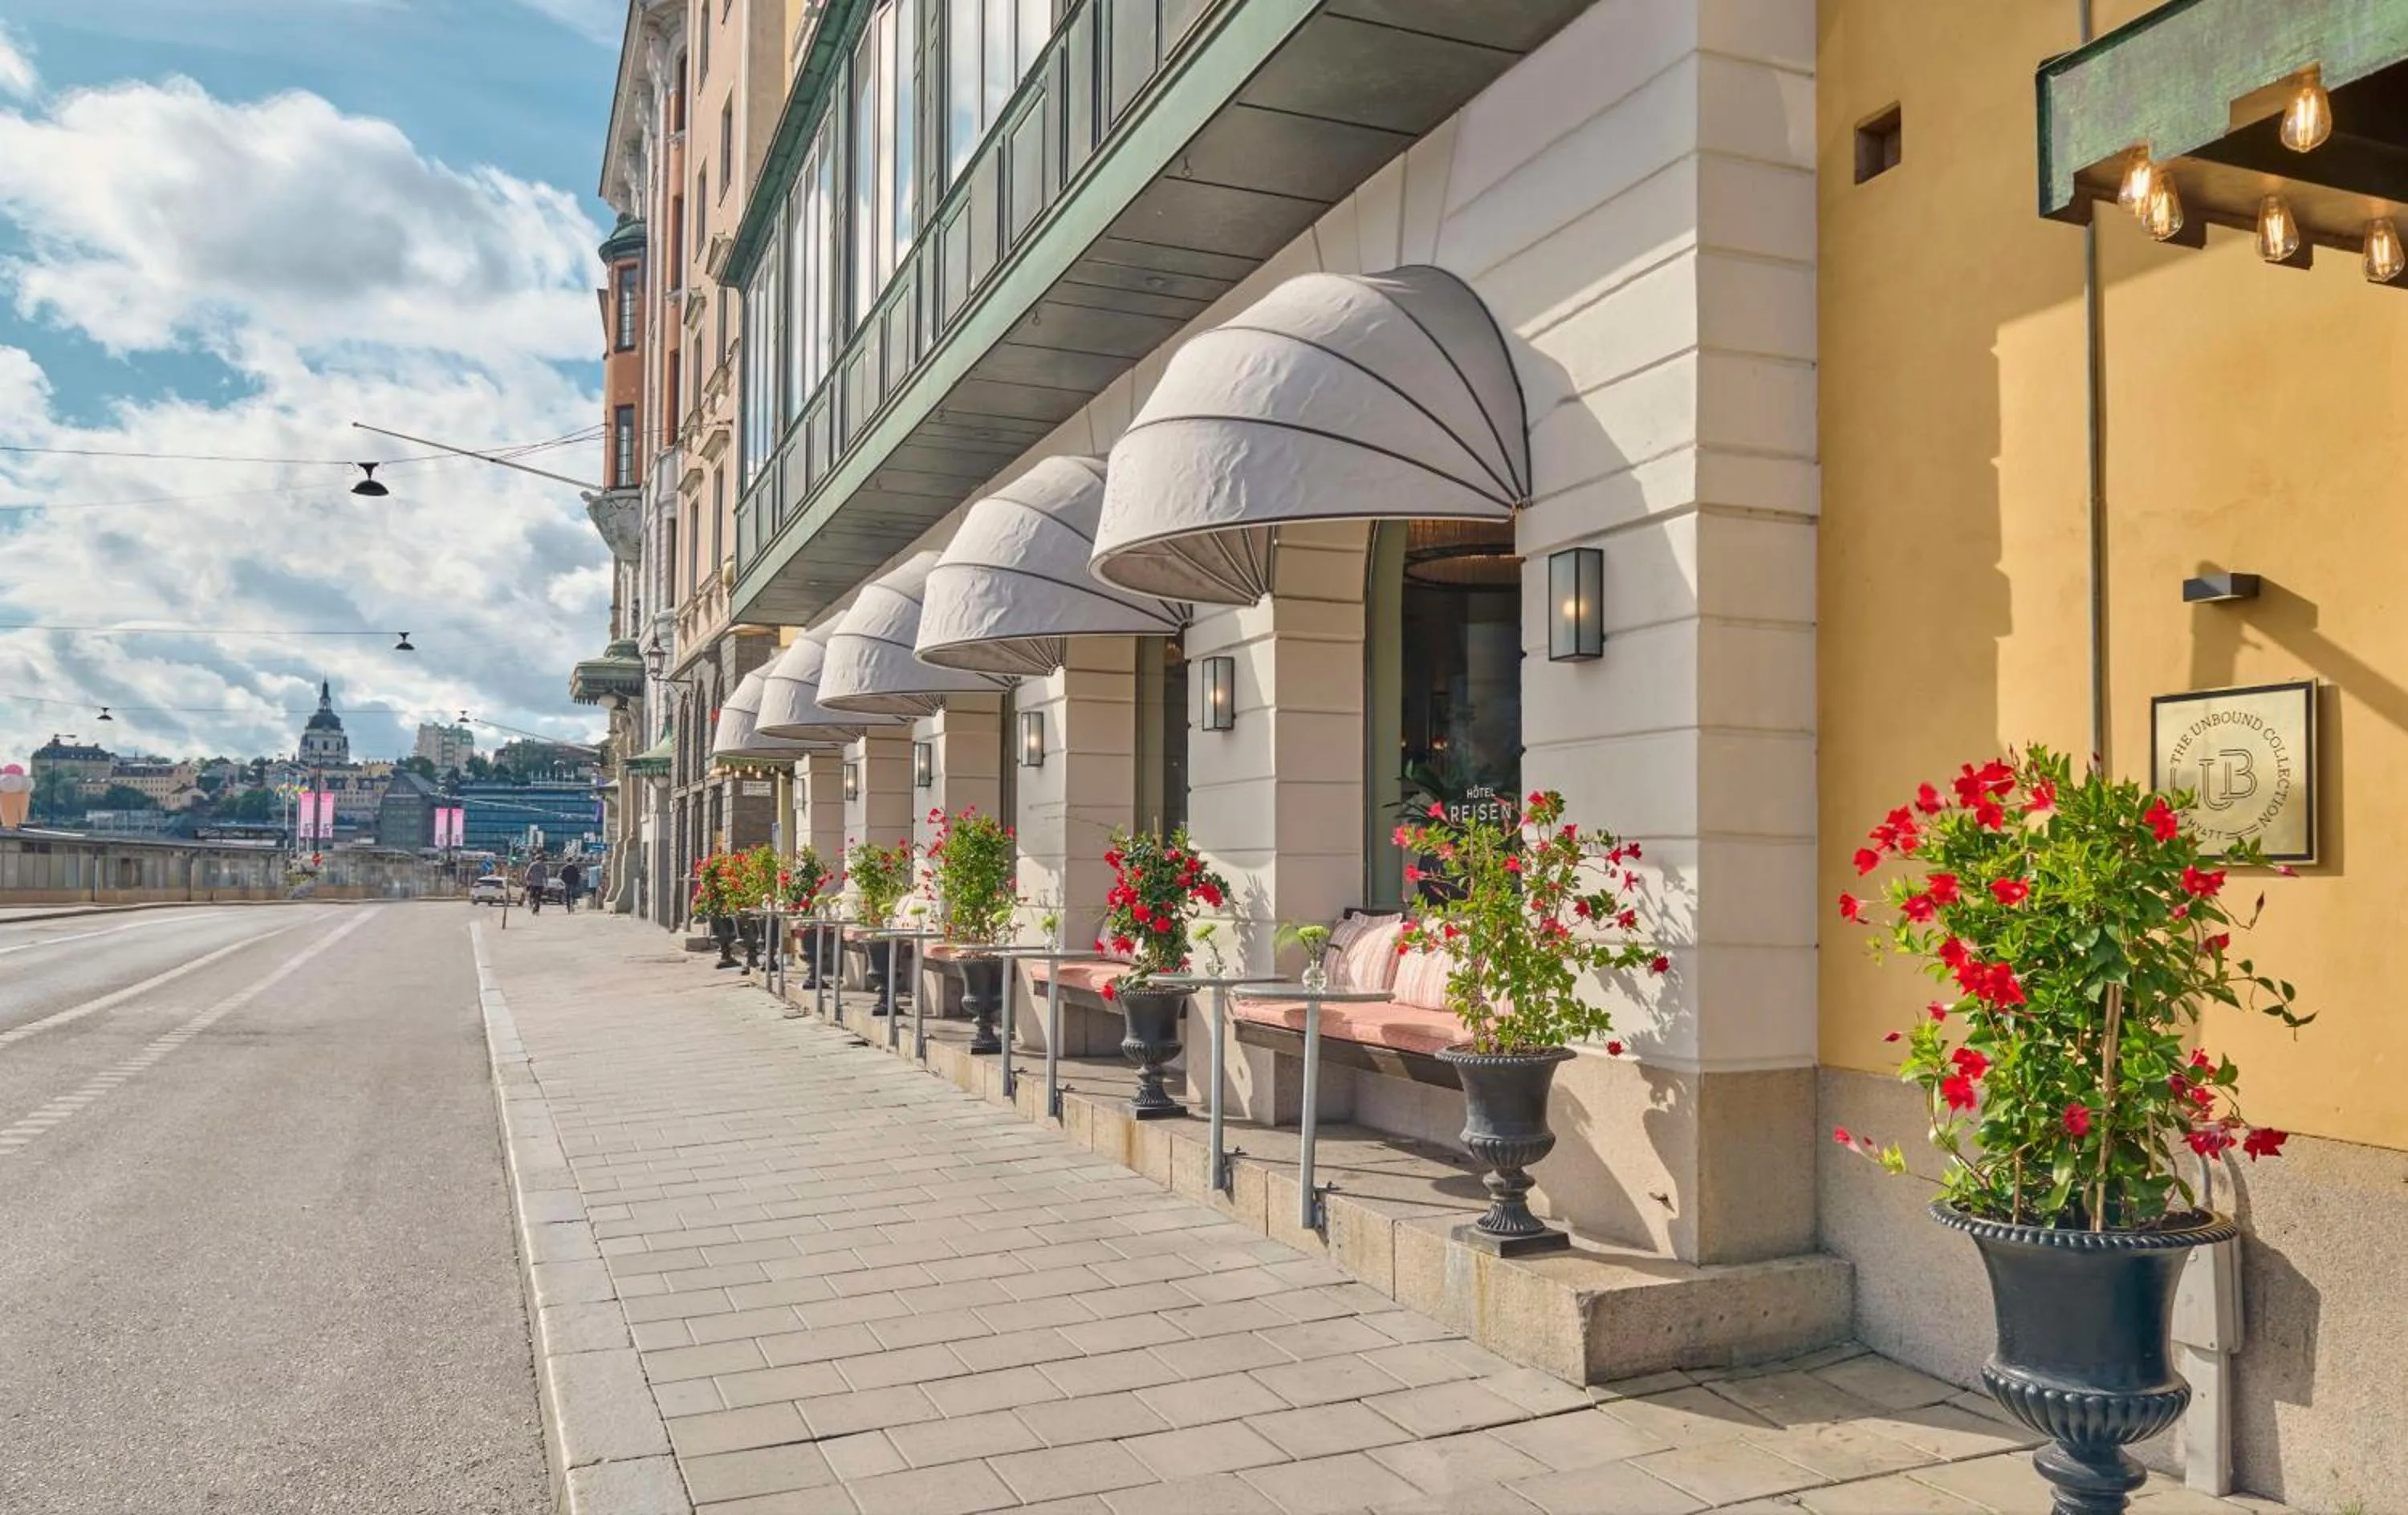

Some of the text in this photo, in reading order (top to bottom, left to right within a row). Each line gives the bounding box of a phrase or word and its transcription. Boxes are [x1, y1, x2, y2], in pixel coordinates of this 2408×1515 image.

[2190, 711, 2263, 736] UNBOUND
[2170, 734, 2192, 764] THE
[2257, 728, 2291, 827] COLLECTION
[1450, 803, 1511, 822] REISEN
[2186, 818, 2222, 840] HYATT
